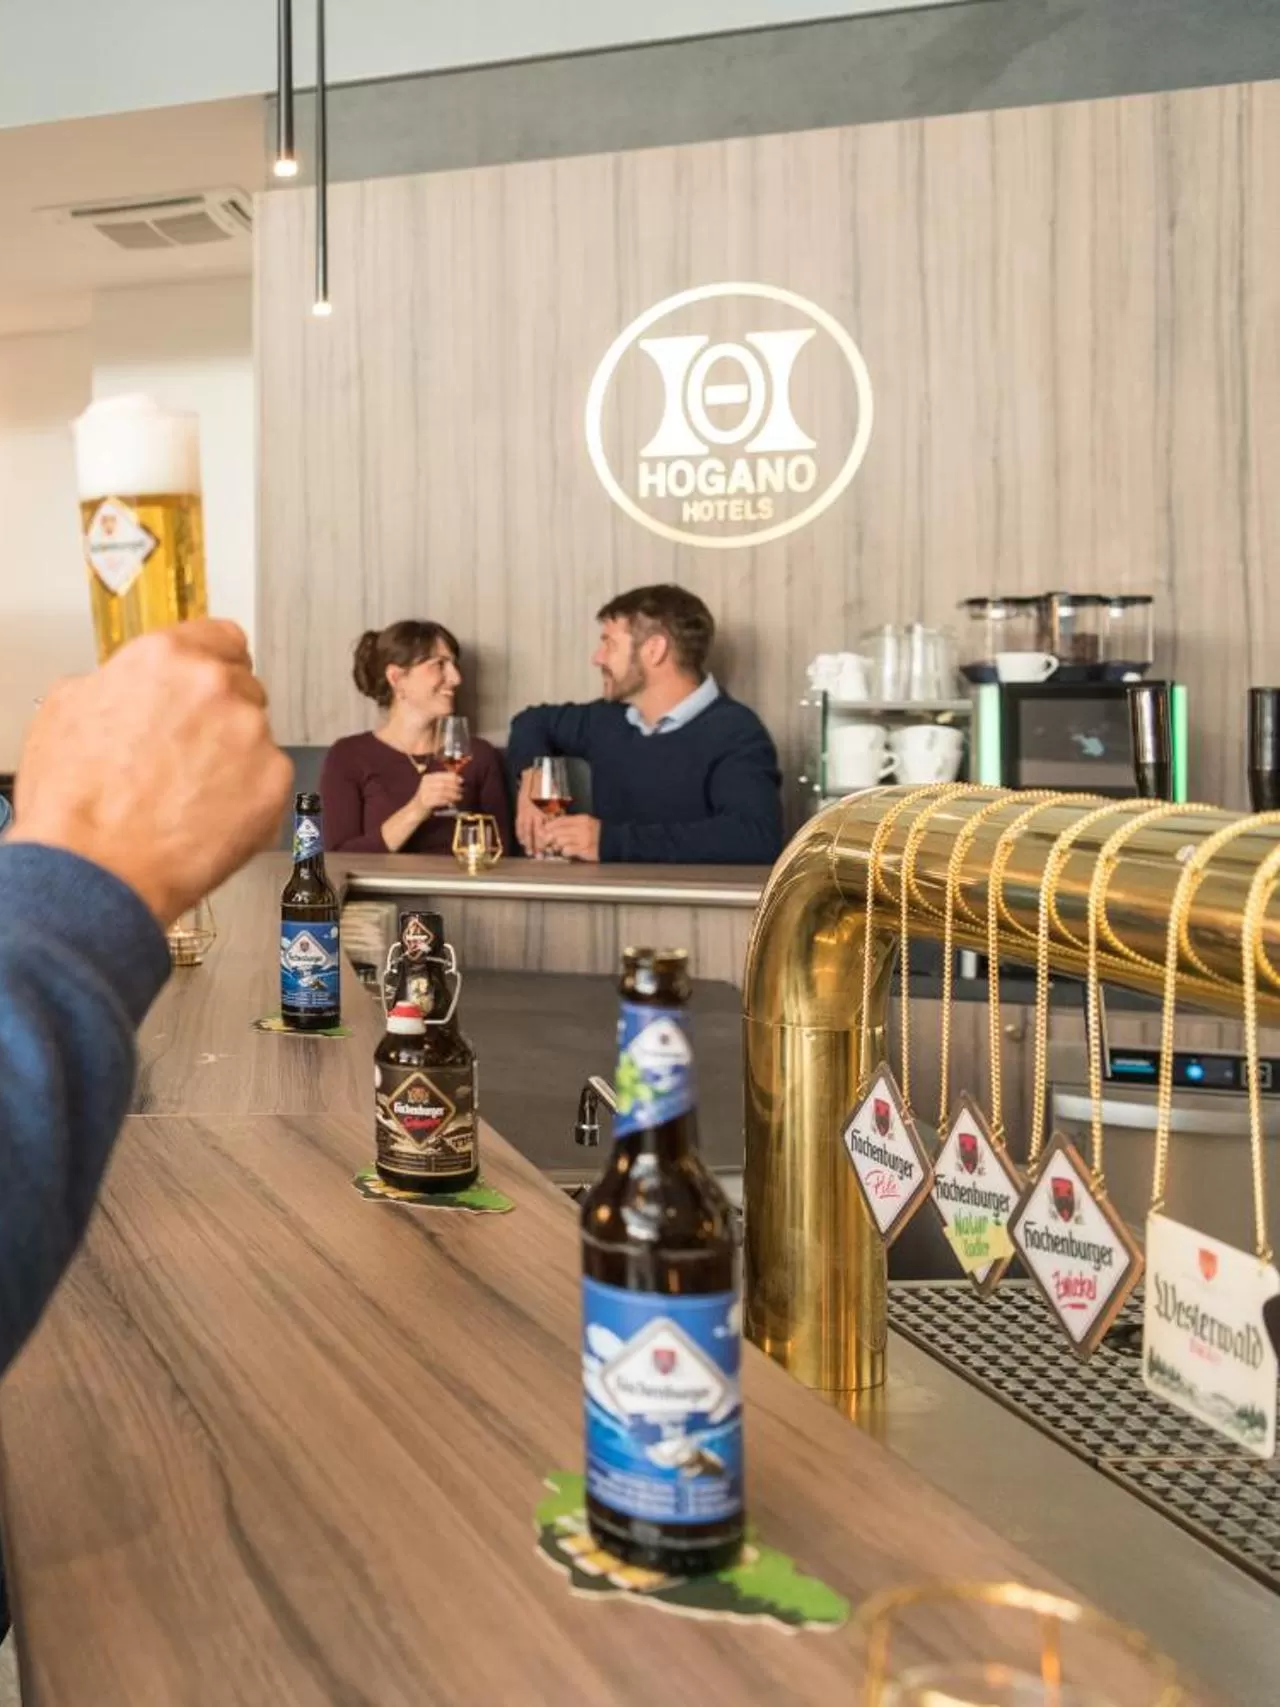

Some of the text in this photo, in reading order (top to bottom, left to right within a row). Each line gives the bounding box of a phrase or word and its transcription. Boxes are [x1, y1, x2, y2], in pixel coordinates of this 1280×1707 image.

[638, 456, 817, 498] HOGANO
[682, 498, 773, 522] HOTELS
[1154, 1271, 1265, 1371] Westerwald
